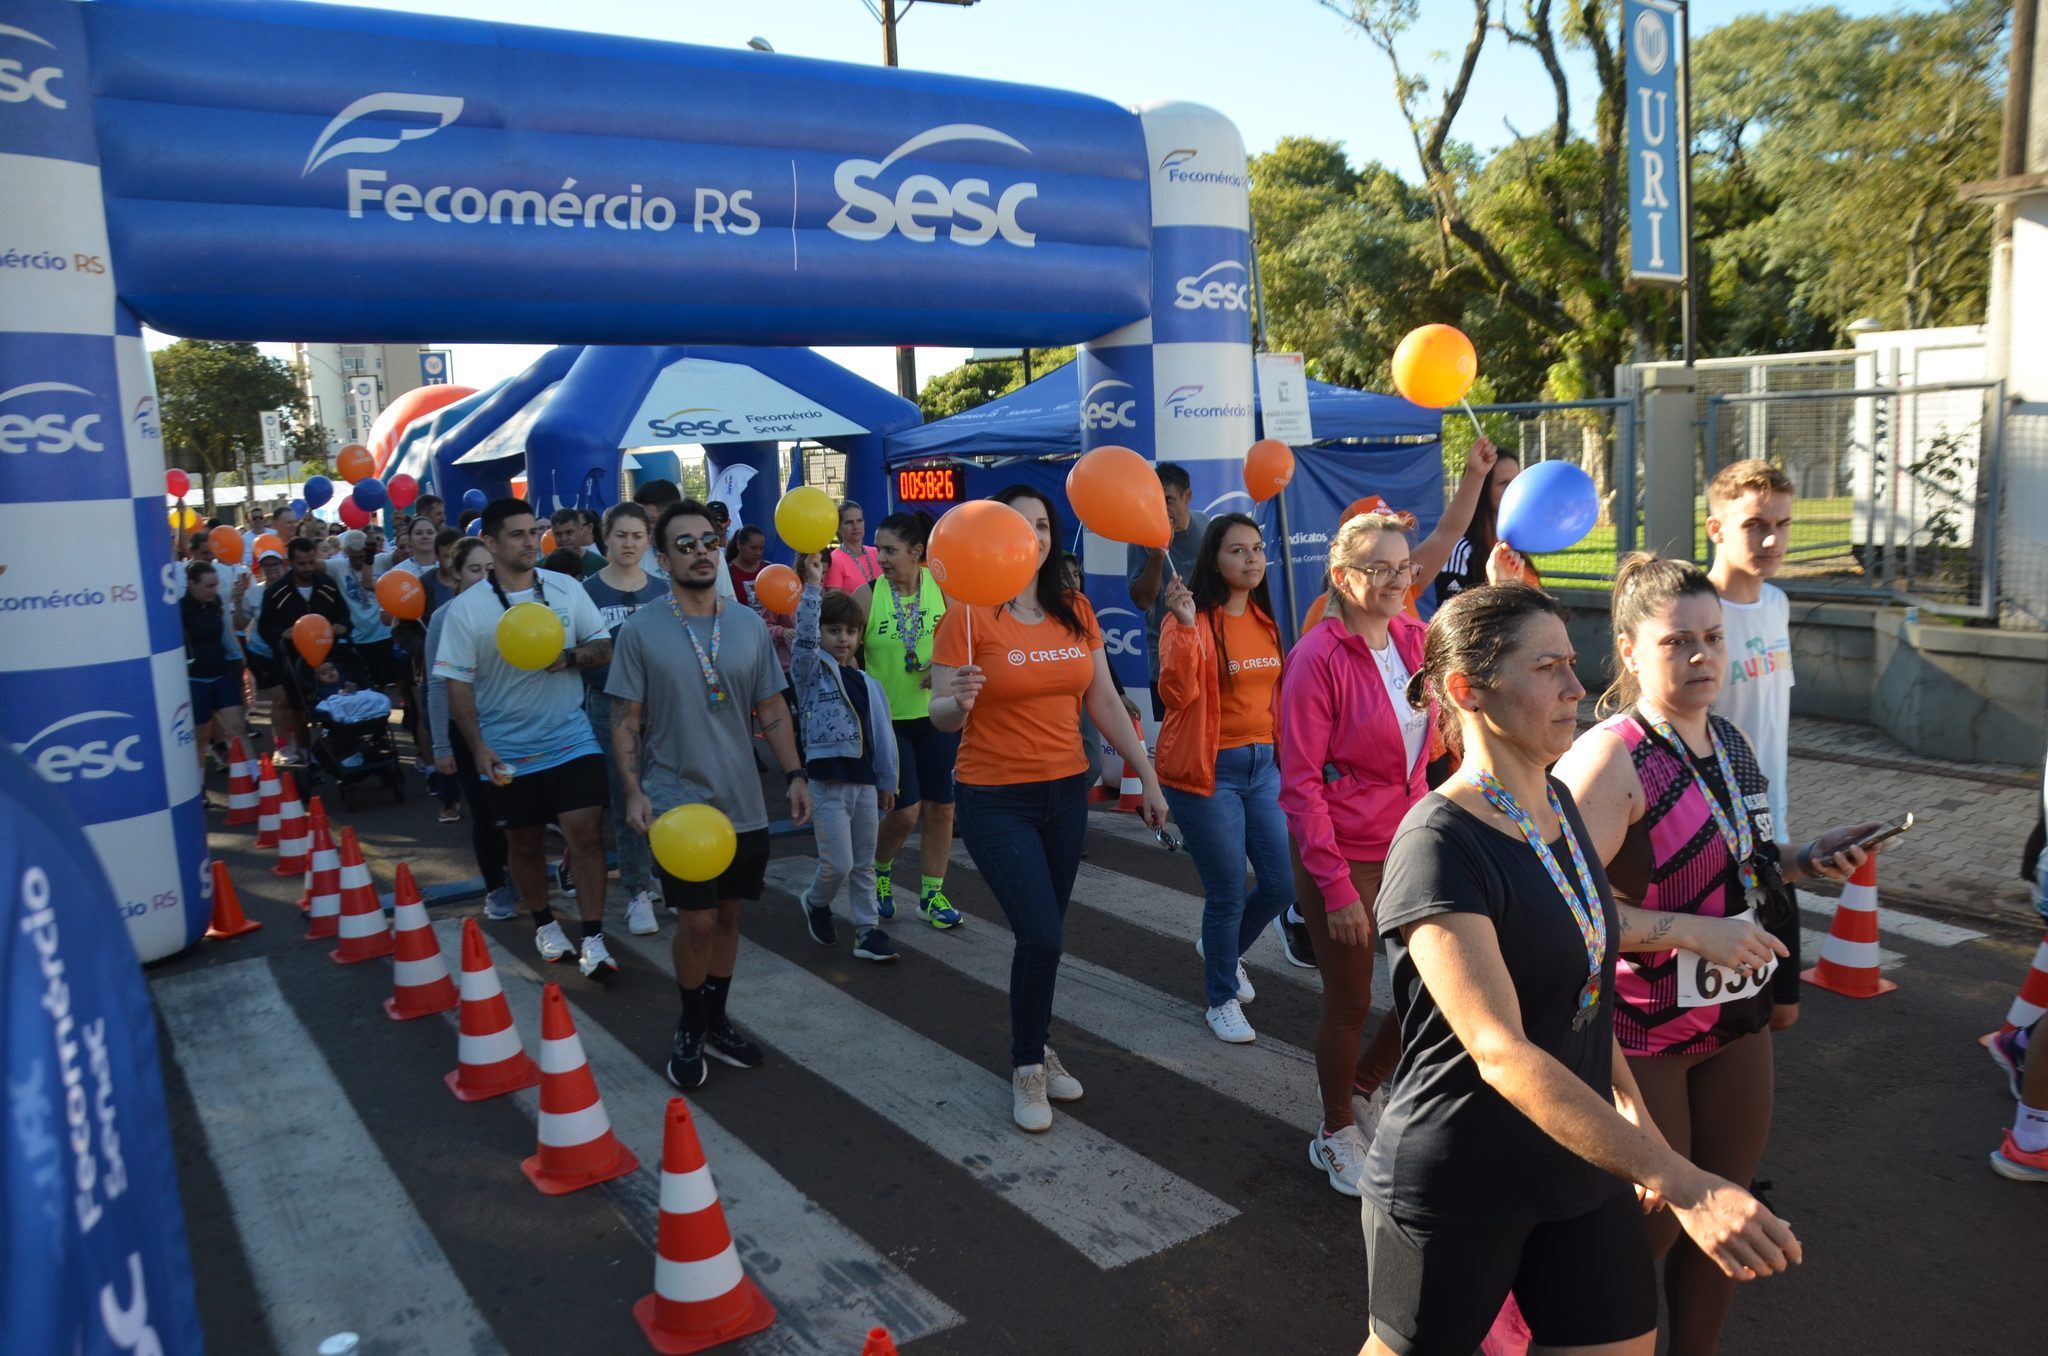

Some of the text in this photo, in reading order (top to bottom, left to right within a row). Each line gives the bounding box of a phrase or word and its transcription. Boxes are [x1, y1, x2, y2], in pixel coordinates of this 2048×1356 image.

[1169, 168, 1241, 187] Fecomércio
[1637, 87, 1669, 268] URI
[347, 168, 761, 236] Fecomércio RS
[827, 158, 1038, 247] Sesc
[74, 253, 106, 275] RS
[1174, 275, 1248, 313] Sesc
[1174, 404, 1246, 419] Fecomércio
[648, 409, 824, 439] Sesc Fecomércio
[111, 583, 138, 603] RS
[1030, 646, 1087, 663] CRESOL
[1242, 656, 1281, 670] CRESOL
[10, 734, 144, 783] esc
[152, 890, 178, 912] RS
